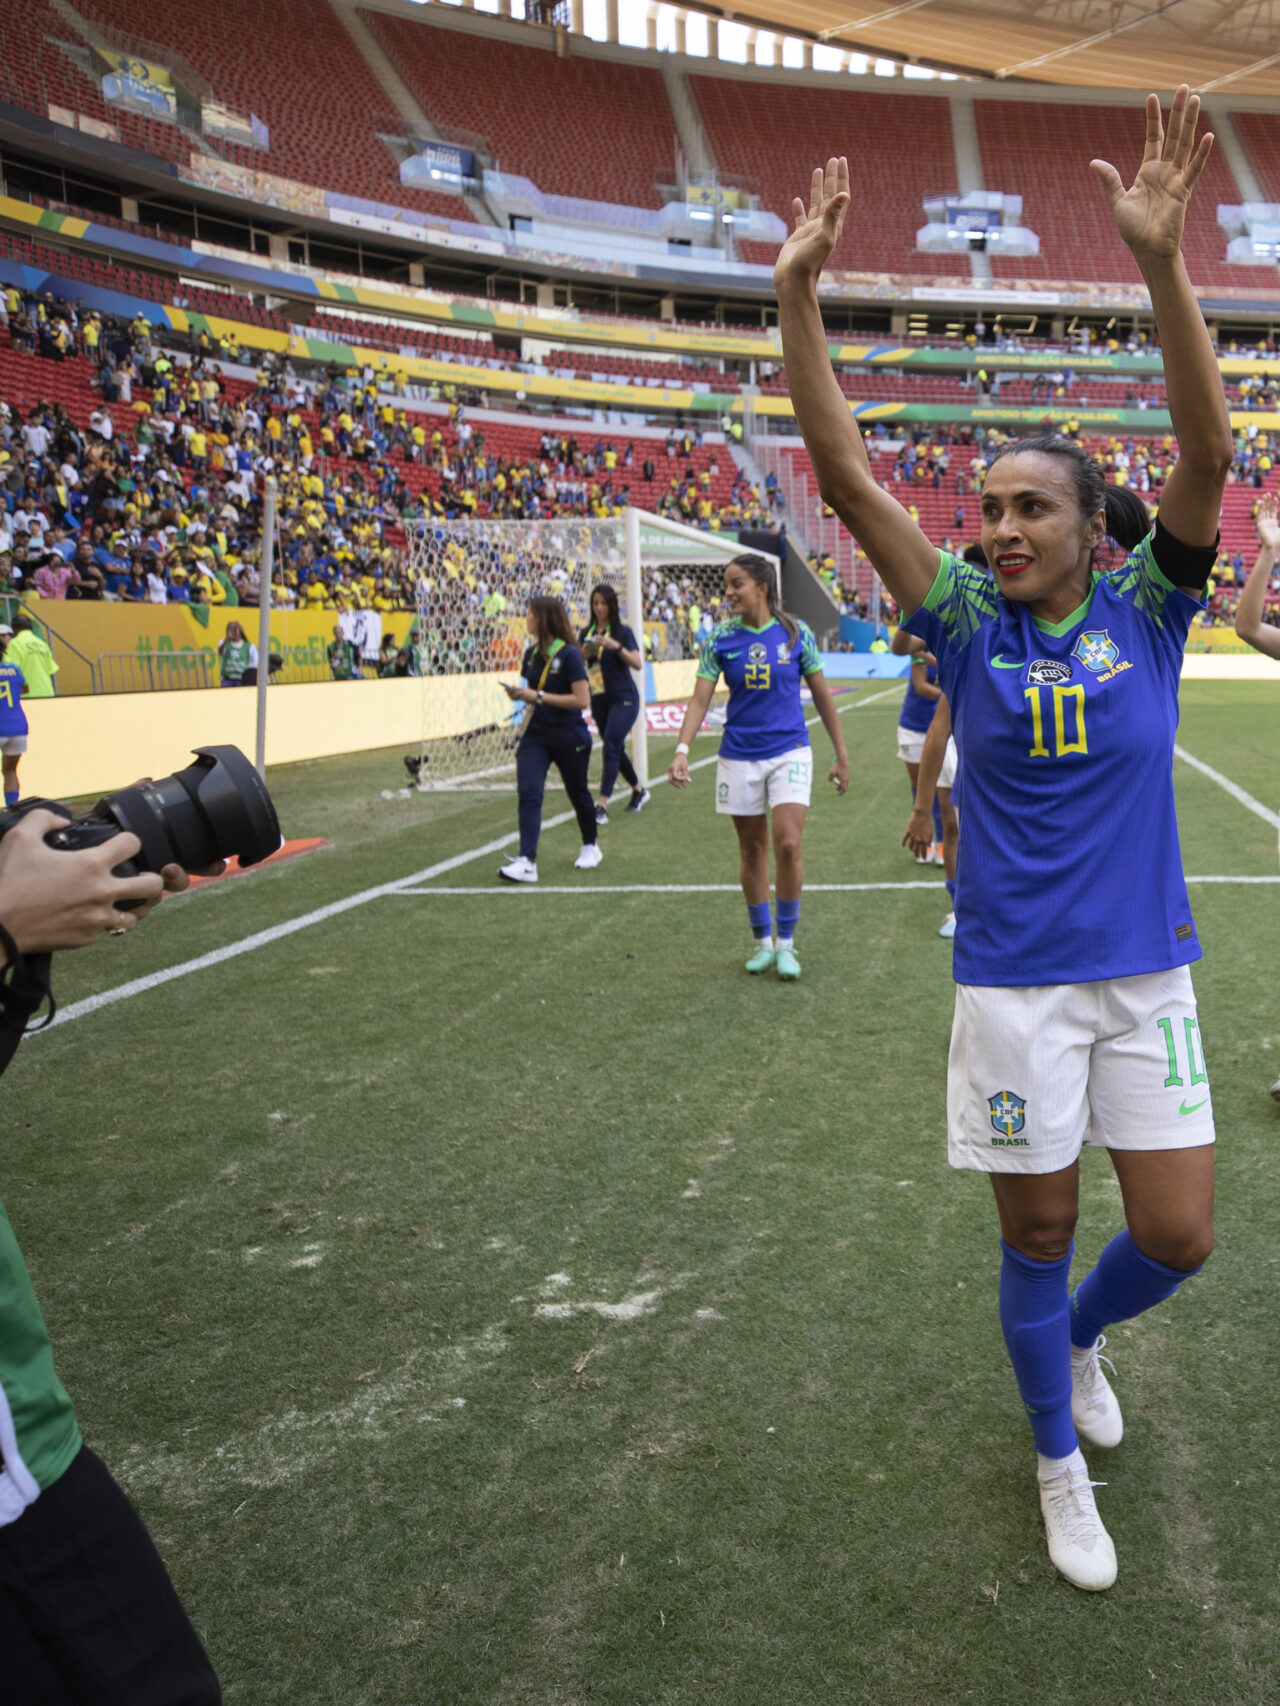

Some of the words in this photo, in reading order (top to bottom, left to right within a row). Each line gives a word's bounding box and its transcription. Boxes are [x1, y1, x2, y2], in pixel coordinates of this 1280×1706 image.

[744, 664, 770, 690] 23
[1096, 660, 1134, 683] BRASIL
[1024, 684, 1088, 758] 10
[999, 1108, 1015, 1117] CBF
[991, 1138, 1030, 1147] BRASIL
